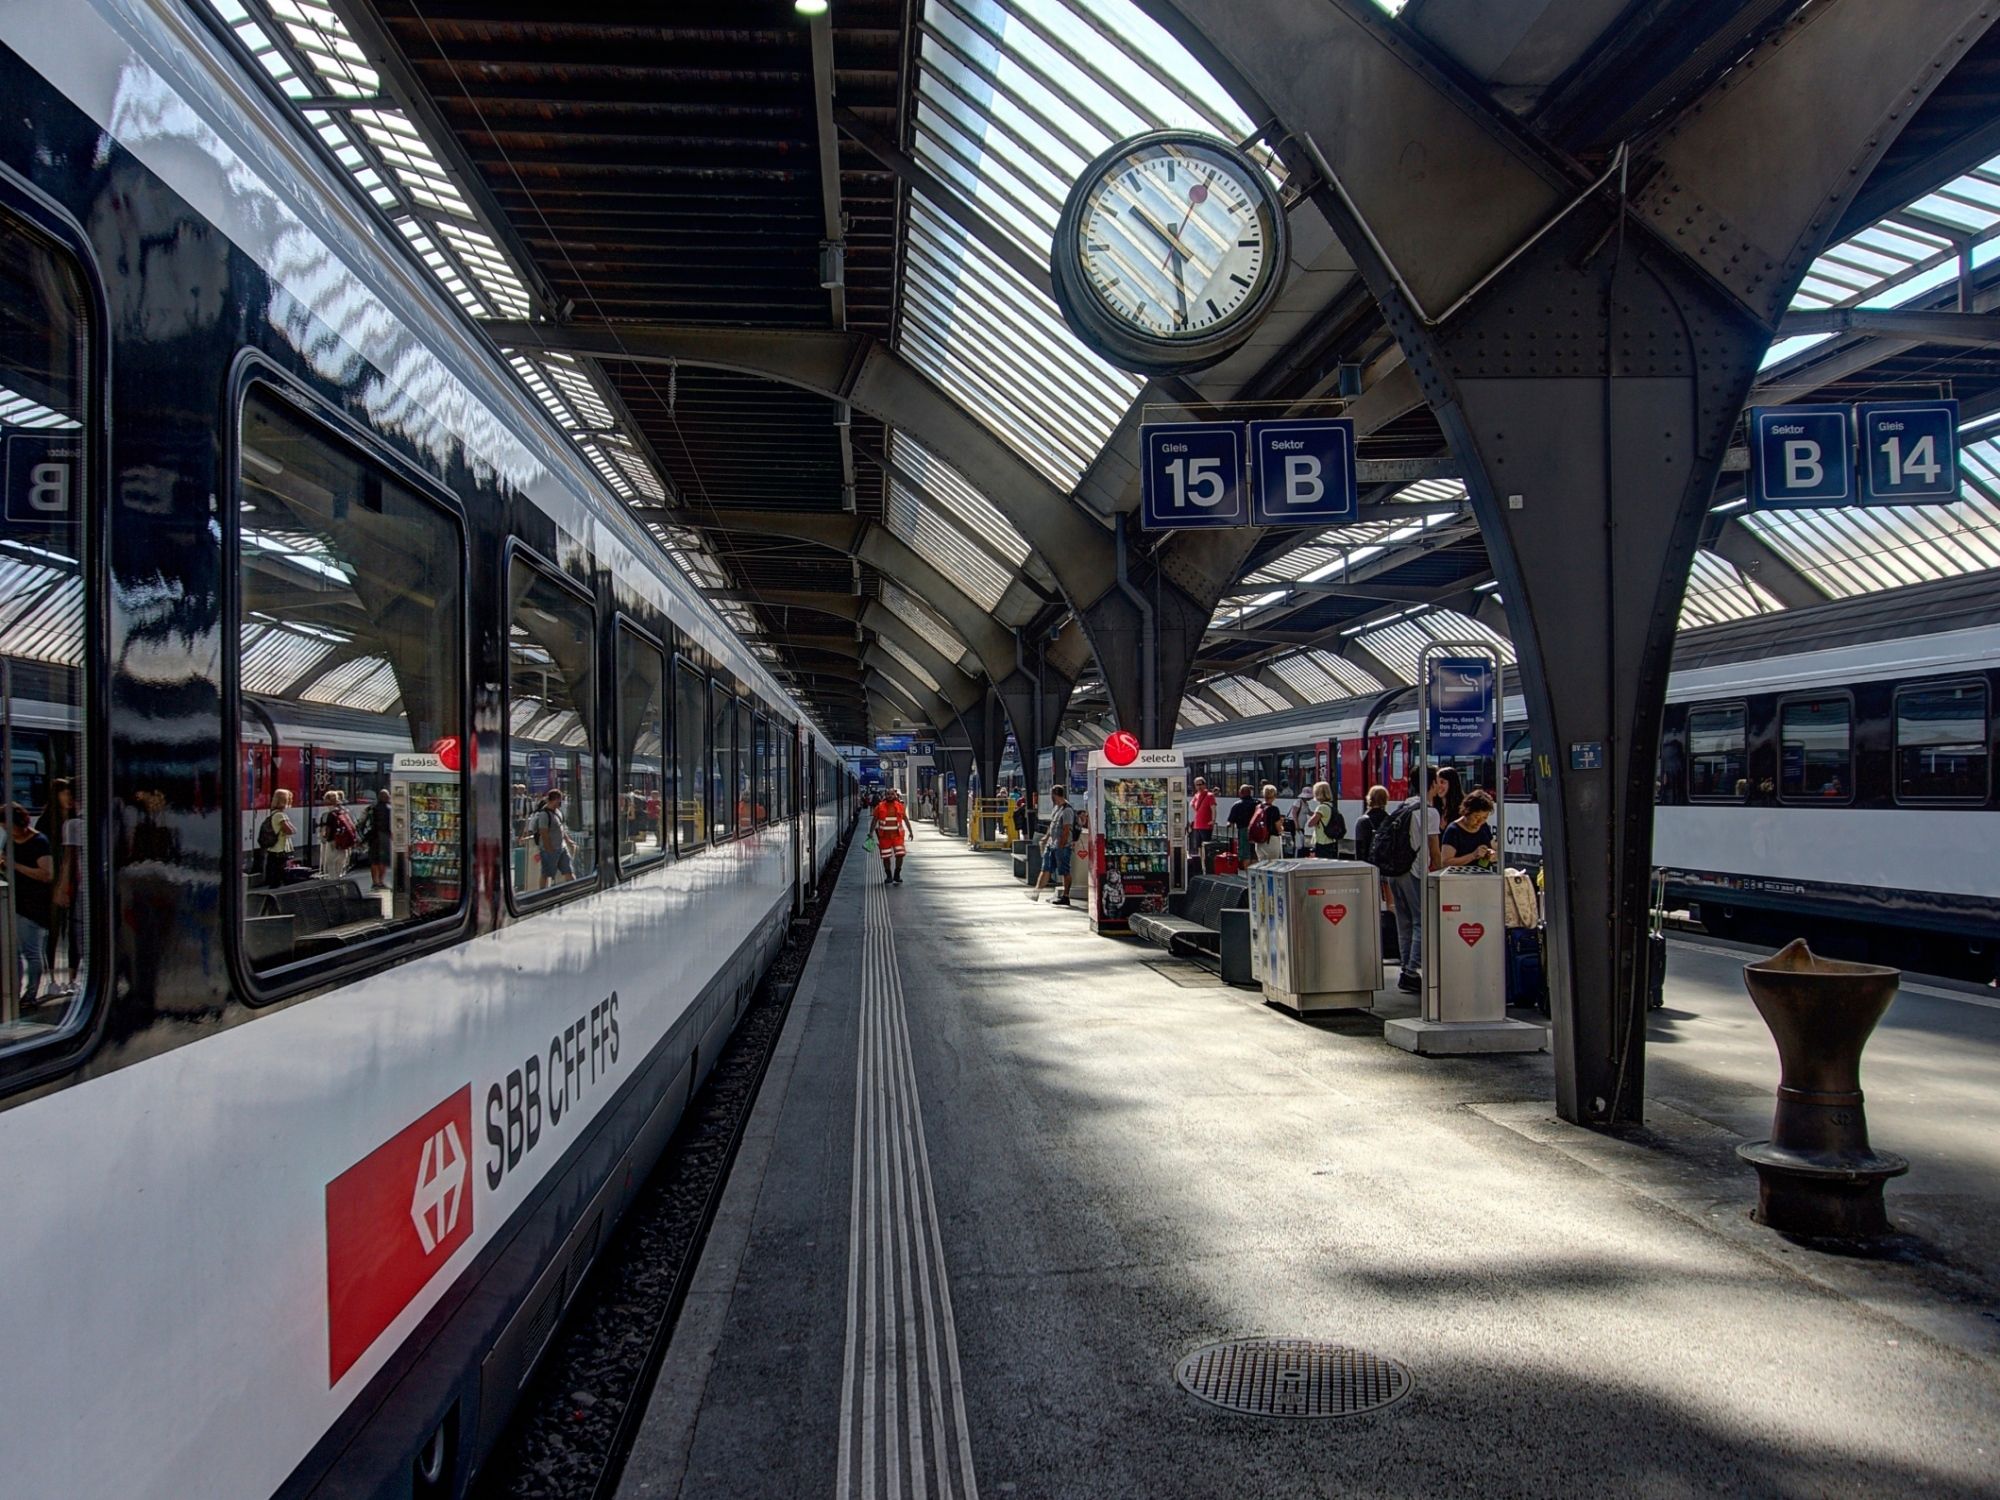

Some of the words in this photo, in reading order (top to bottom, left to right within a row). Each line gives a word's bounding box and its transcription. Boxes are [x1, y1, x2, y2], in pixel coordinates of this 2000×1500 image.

[1771, 425, 1805, 435] Sektor
[1878, 422, 1904, 431] Gleis
[1162, 443, 1188, 453] Gleis
[1271, 440, 1304, 450] Sektor
[1784, 440, 1824, 488] B
[1880, 435, 1941, 485] 14
[1165, 458, 1225, 508] 15
[1285, 455, 1325, 504] B
[1337, 743, 1341, 758] 2
[1382, 741, 1387, 757] 2
[1141, 752, 1176, 763] selecta
[1507, 826, 1525, 845] CFF
[1528, 827, 1542, 847] FF
[486, 1054, 541, 1191] SBB
[548, 1015, 586, 1127] CFF
[591, 990, 620, 1085] FFS
